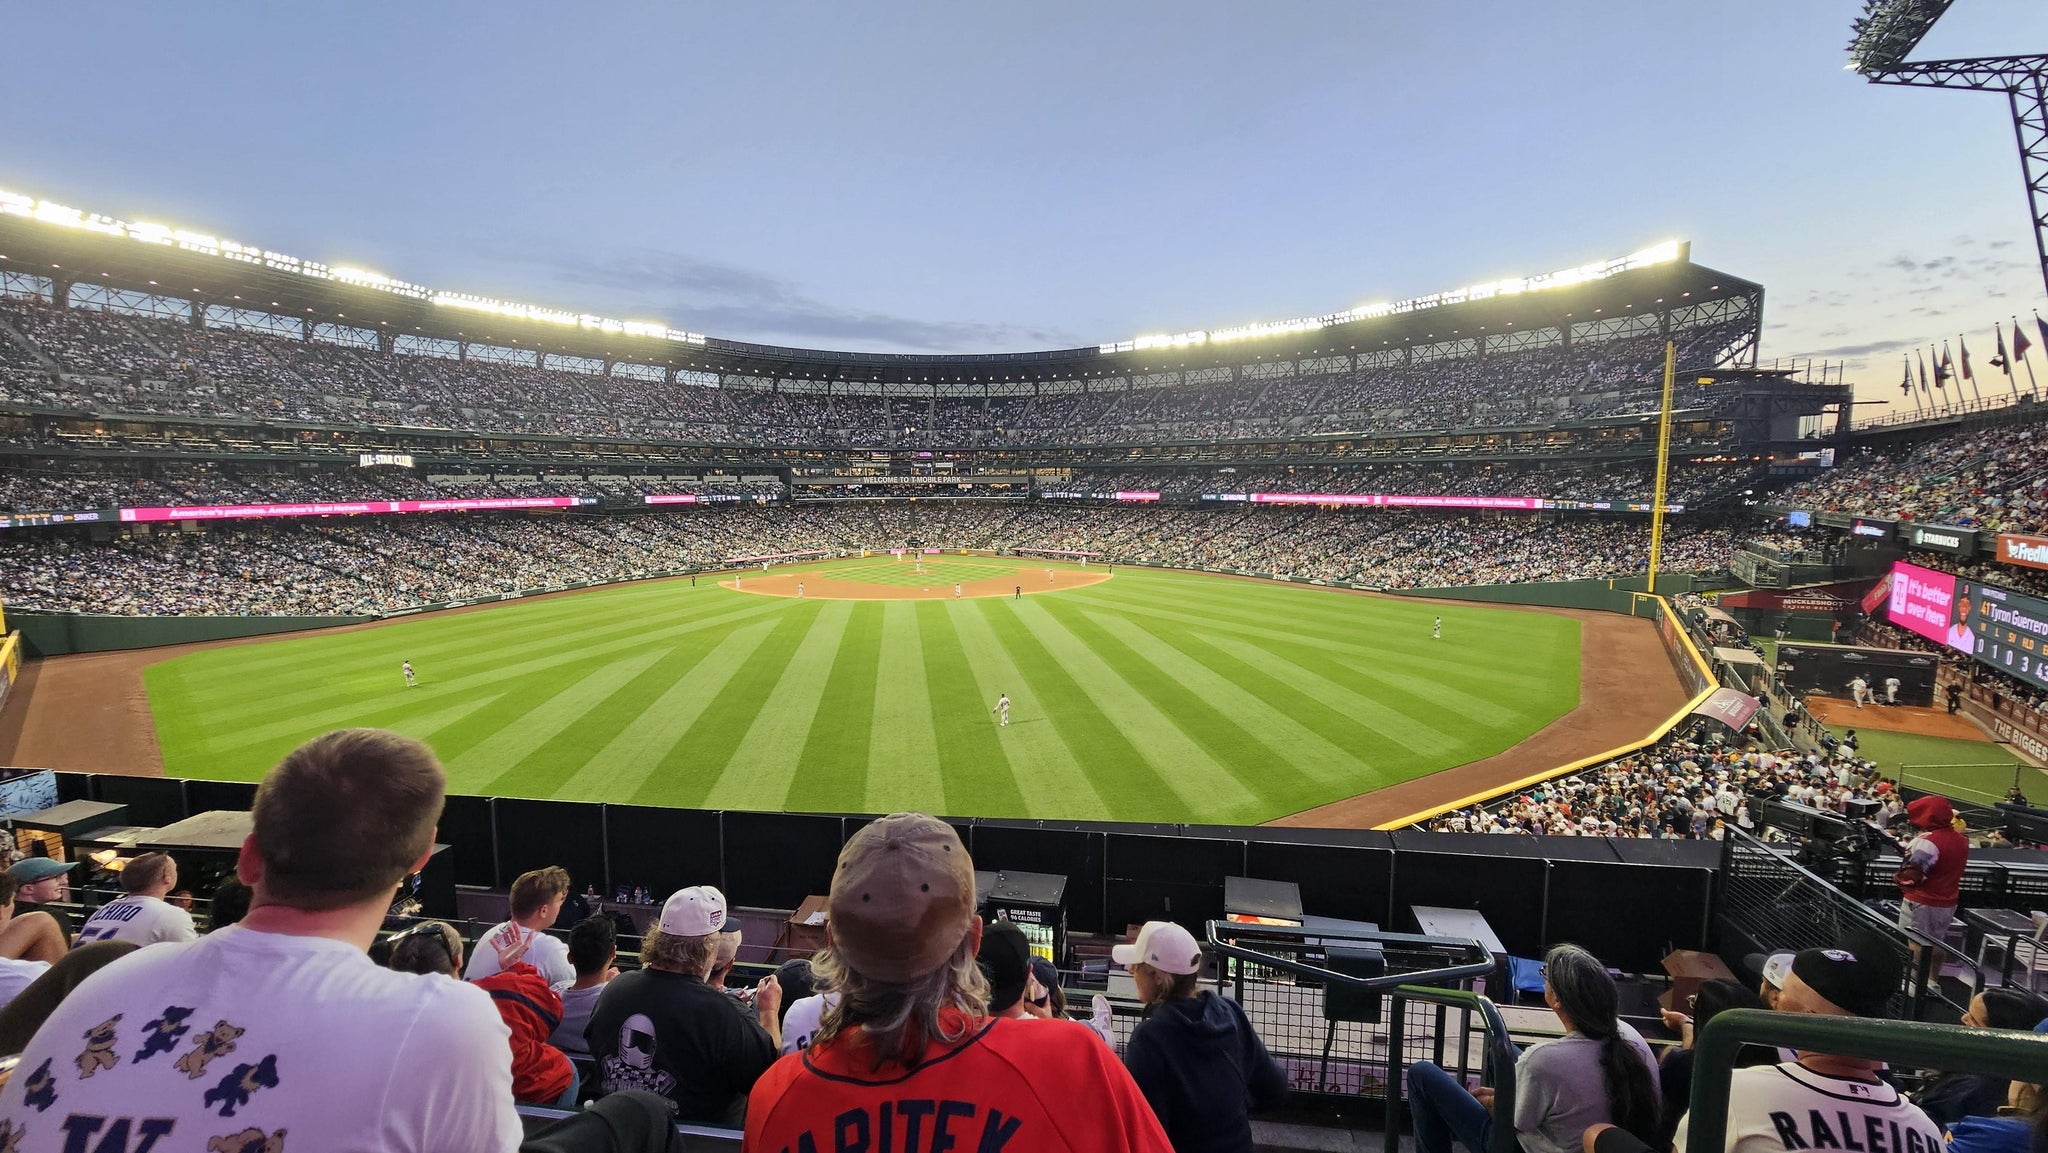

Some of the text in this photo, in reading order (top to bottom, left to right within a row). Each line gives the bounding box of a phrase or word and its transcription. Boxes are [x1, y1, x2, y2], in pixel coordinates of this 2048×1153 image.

[360, 454, 412, 467] ALL-STAR CLUB
[52, 514, 64, 522] 101
[73, 513, 99, 521] SINKER
[169, 509, 223, 518] America's
[224, 508, 266, 519] pastime.
[268, 506, 313, 515] America's
[334, 504, 370, 512] Network.
[1923, 532, 1961, 548] STARBUCKS
[1273, 574, 1291, 582] STIHL
[1783, 598, 1844, 607] MUCKLESHOOT
[1908, 578, 1921, 596] It's
[1921, 582, 1952, 607] better
[1906, 602, 1946, 627] over here
[1980, 600, 2048, 636] 41 Tyron Guerrero
[1994, 627, 1999, 638] L
[2021, 637, 2035, 651] HLD
[1977, 638, 1985, 653] 0
[1992, 644, 1998, 659] 1
[2006, 650, 2014, 666] 0
[2021, 656, 2029, 673] 3
[1994, 718, 2048, 762] THE BIGGES
[780, 1100, 1022, 1153] RITEK
